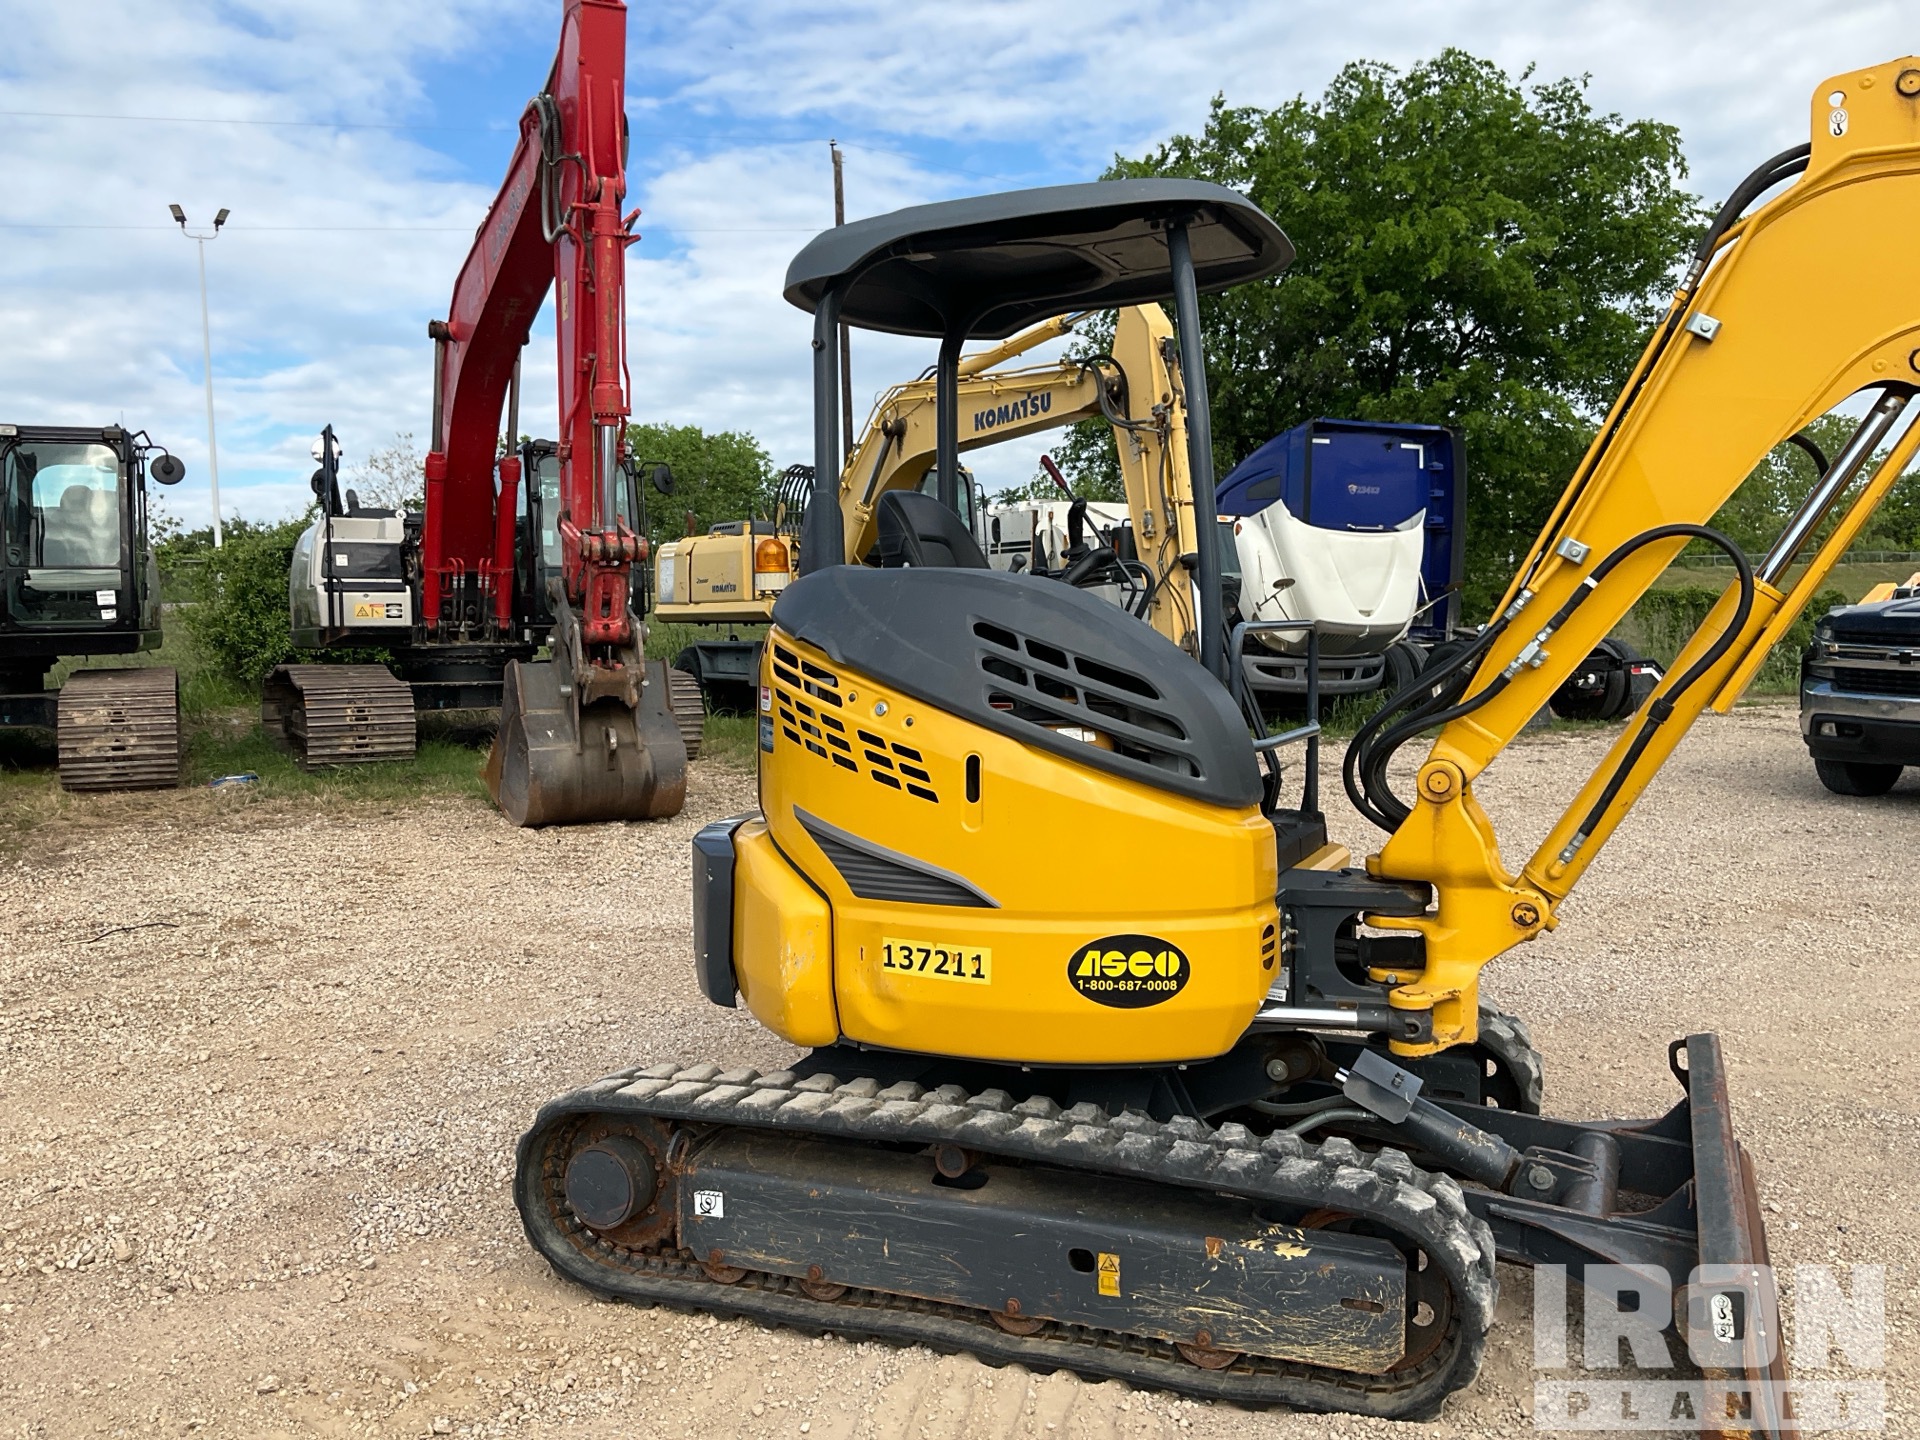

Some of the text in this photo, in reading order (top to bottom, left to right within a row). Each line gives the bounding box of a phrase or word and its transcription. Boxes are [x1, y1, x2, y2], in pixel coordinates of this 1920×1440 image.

[974, 391, 1052, 432] KOMATSU
[882, 944, 986, 979] 137211
[1076, 950, 1180, 978] ASCO
[1077, 980, 1178, 991] 1-800-687-0008
